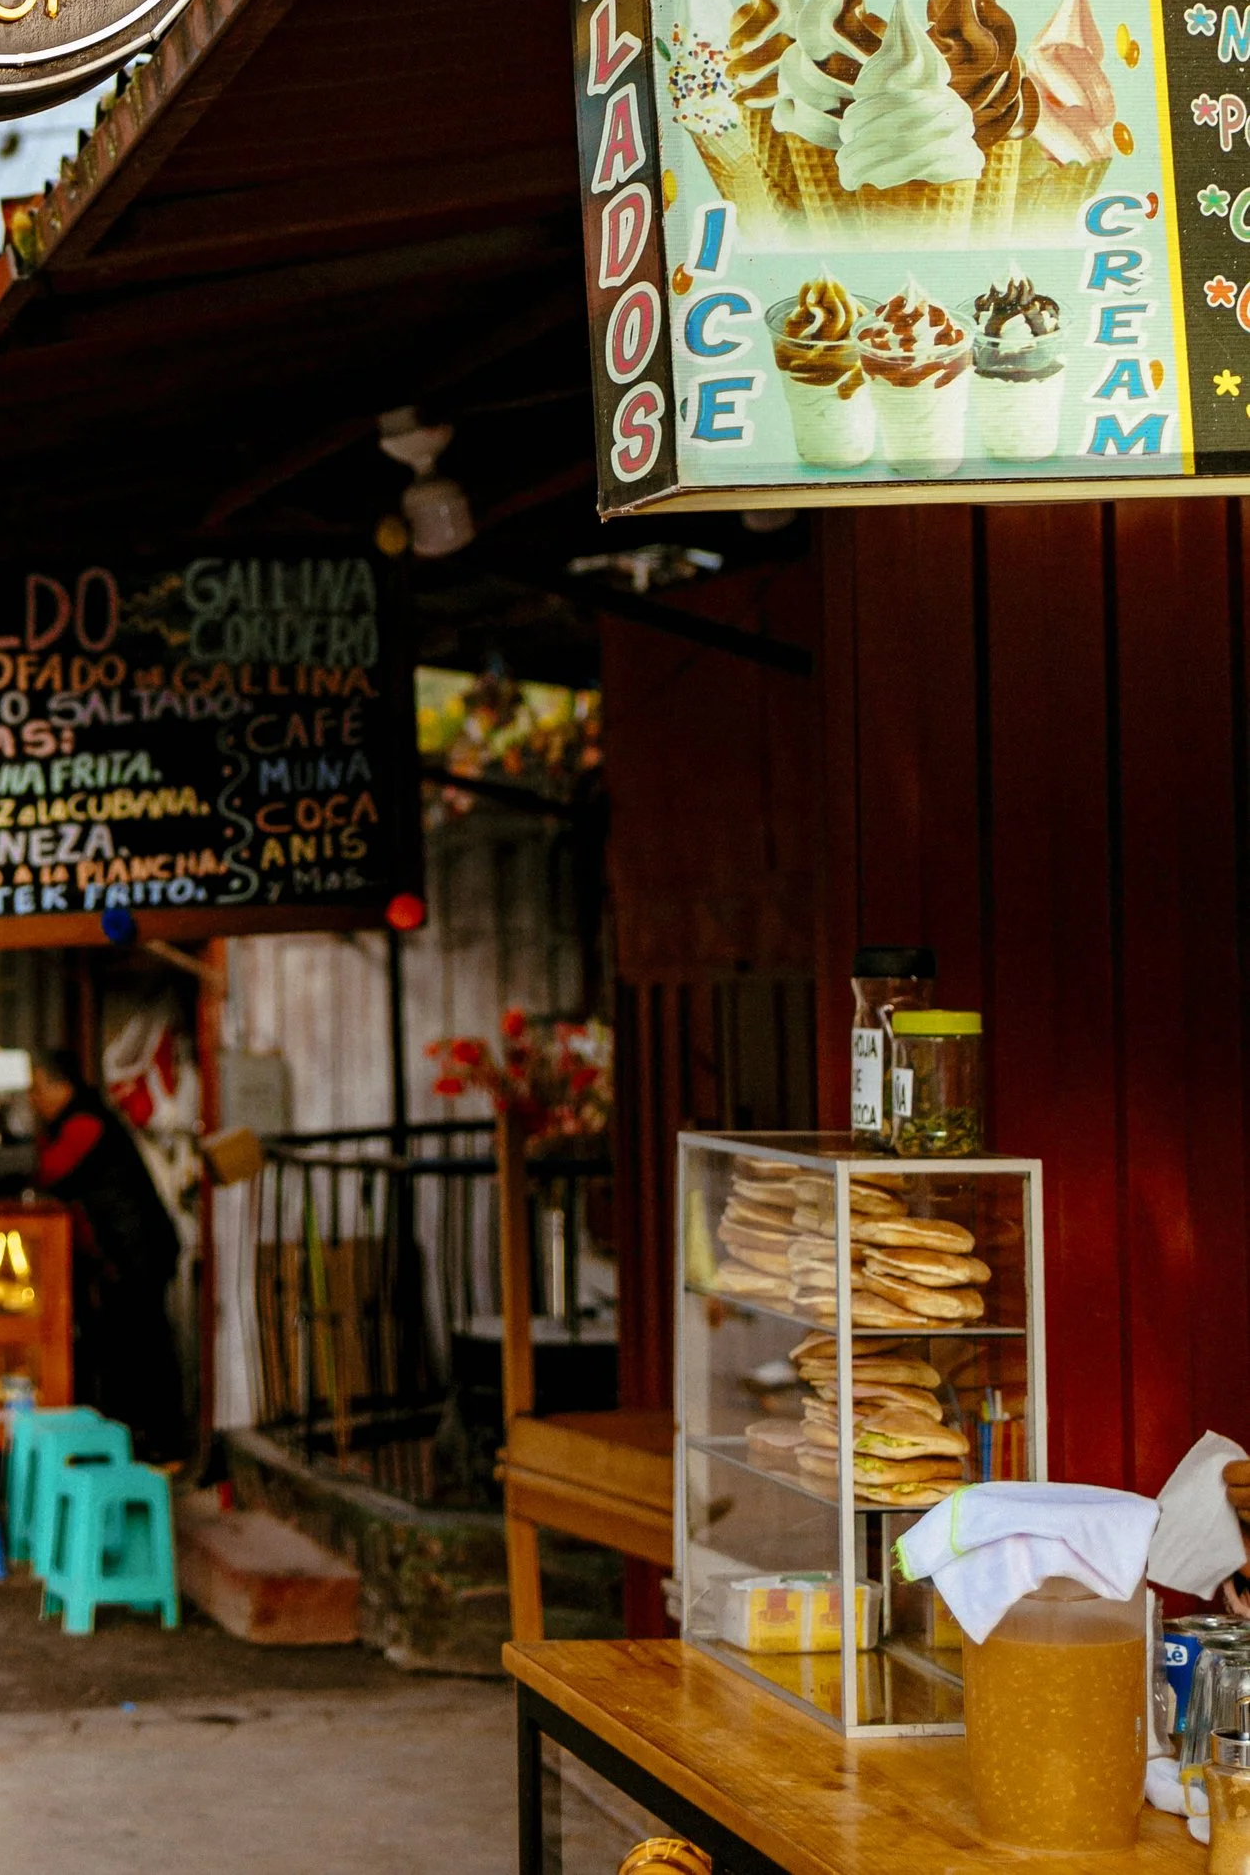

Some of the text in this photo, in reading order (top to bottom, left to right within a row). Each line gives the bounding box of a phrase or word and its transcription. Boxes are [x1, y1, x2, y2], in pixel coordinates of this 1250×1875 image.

[683, 206, 756, 442] ICE
[1085, 196, 1170, 457] CREAM
[182, 557, 379, 615] GALLINA
[254, 789, 380, 835] COCA
